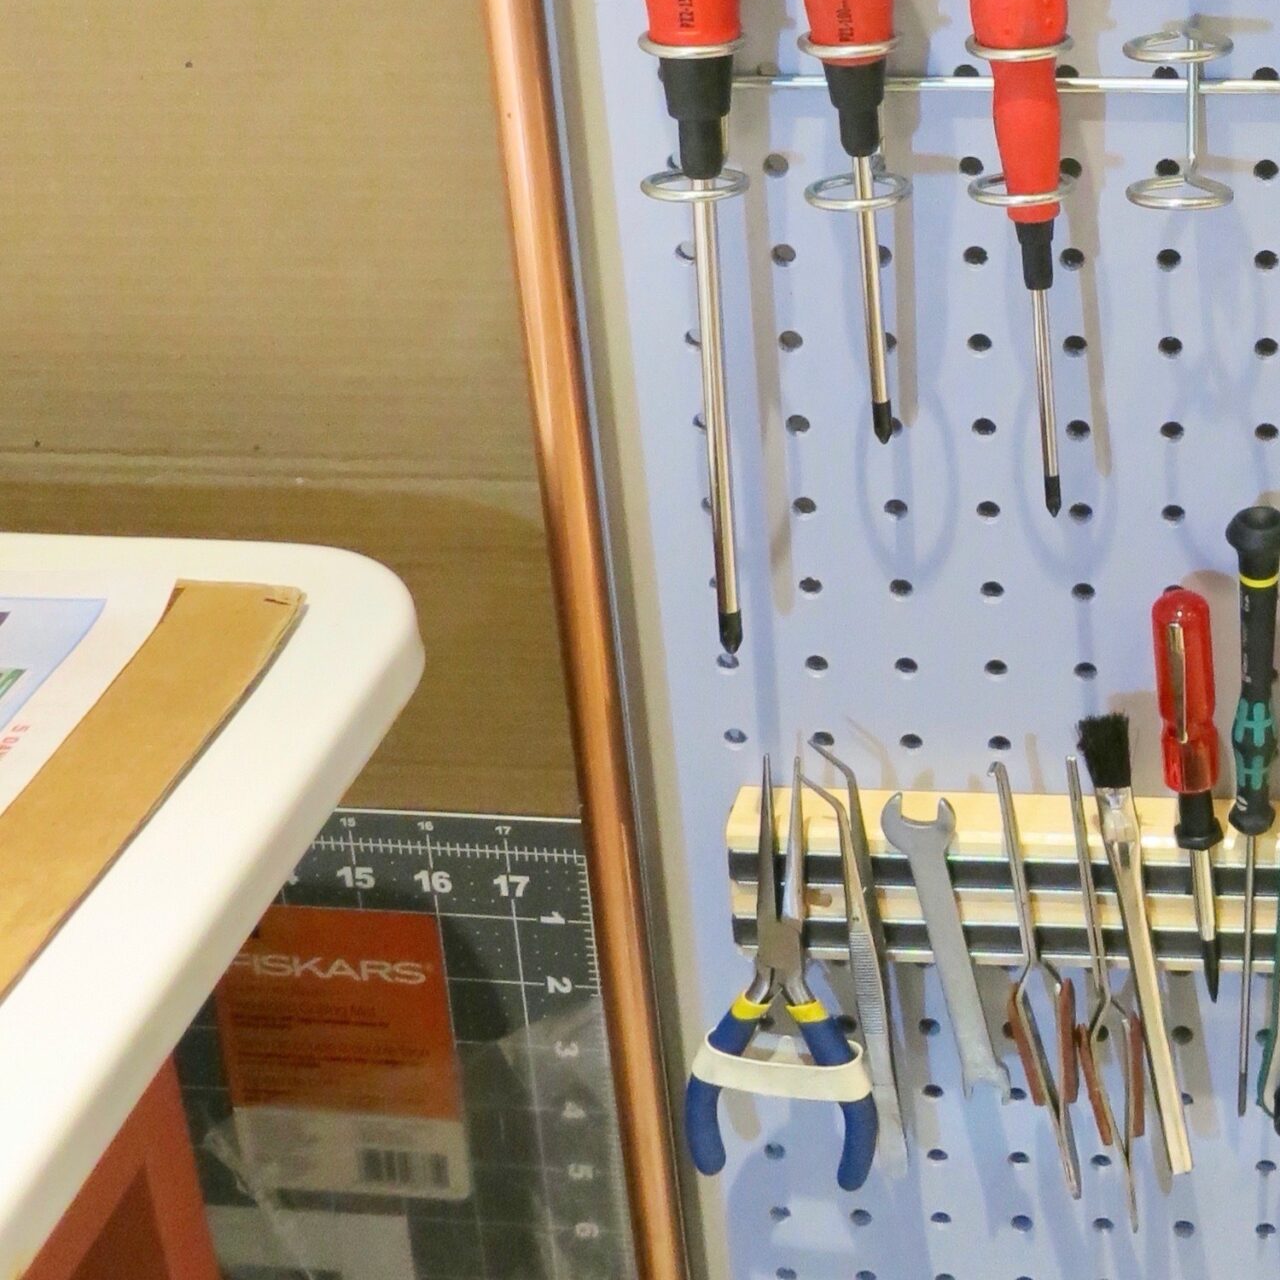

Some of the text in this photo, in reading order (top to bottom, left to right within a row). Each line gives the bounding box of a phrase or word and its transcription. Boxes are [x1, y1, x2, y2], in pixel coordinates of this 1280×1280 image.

[339, 817, 511, 835] 15 16 17
[336, 866, 530, 898] 15 16 17
[546, 976, 573, 994] 2
